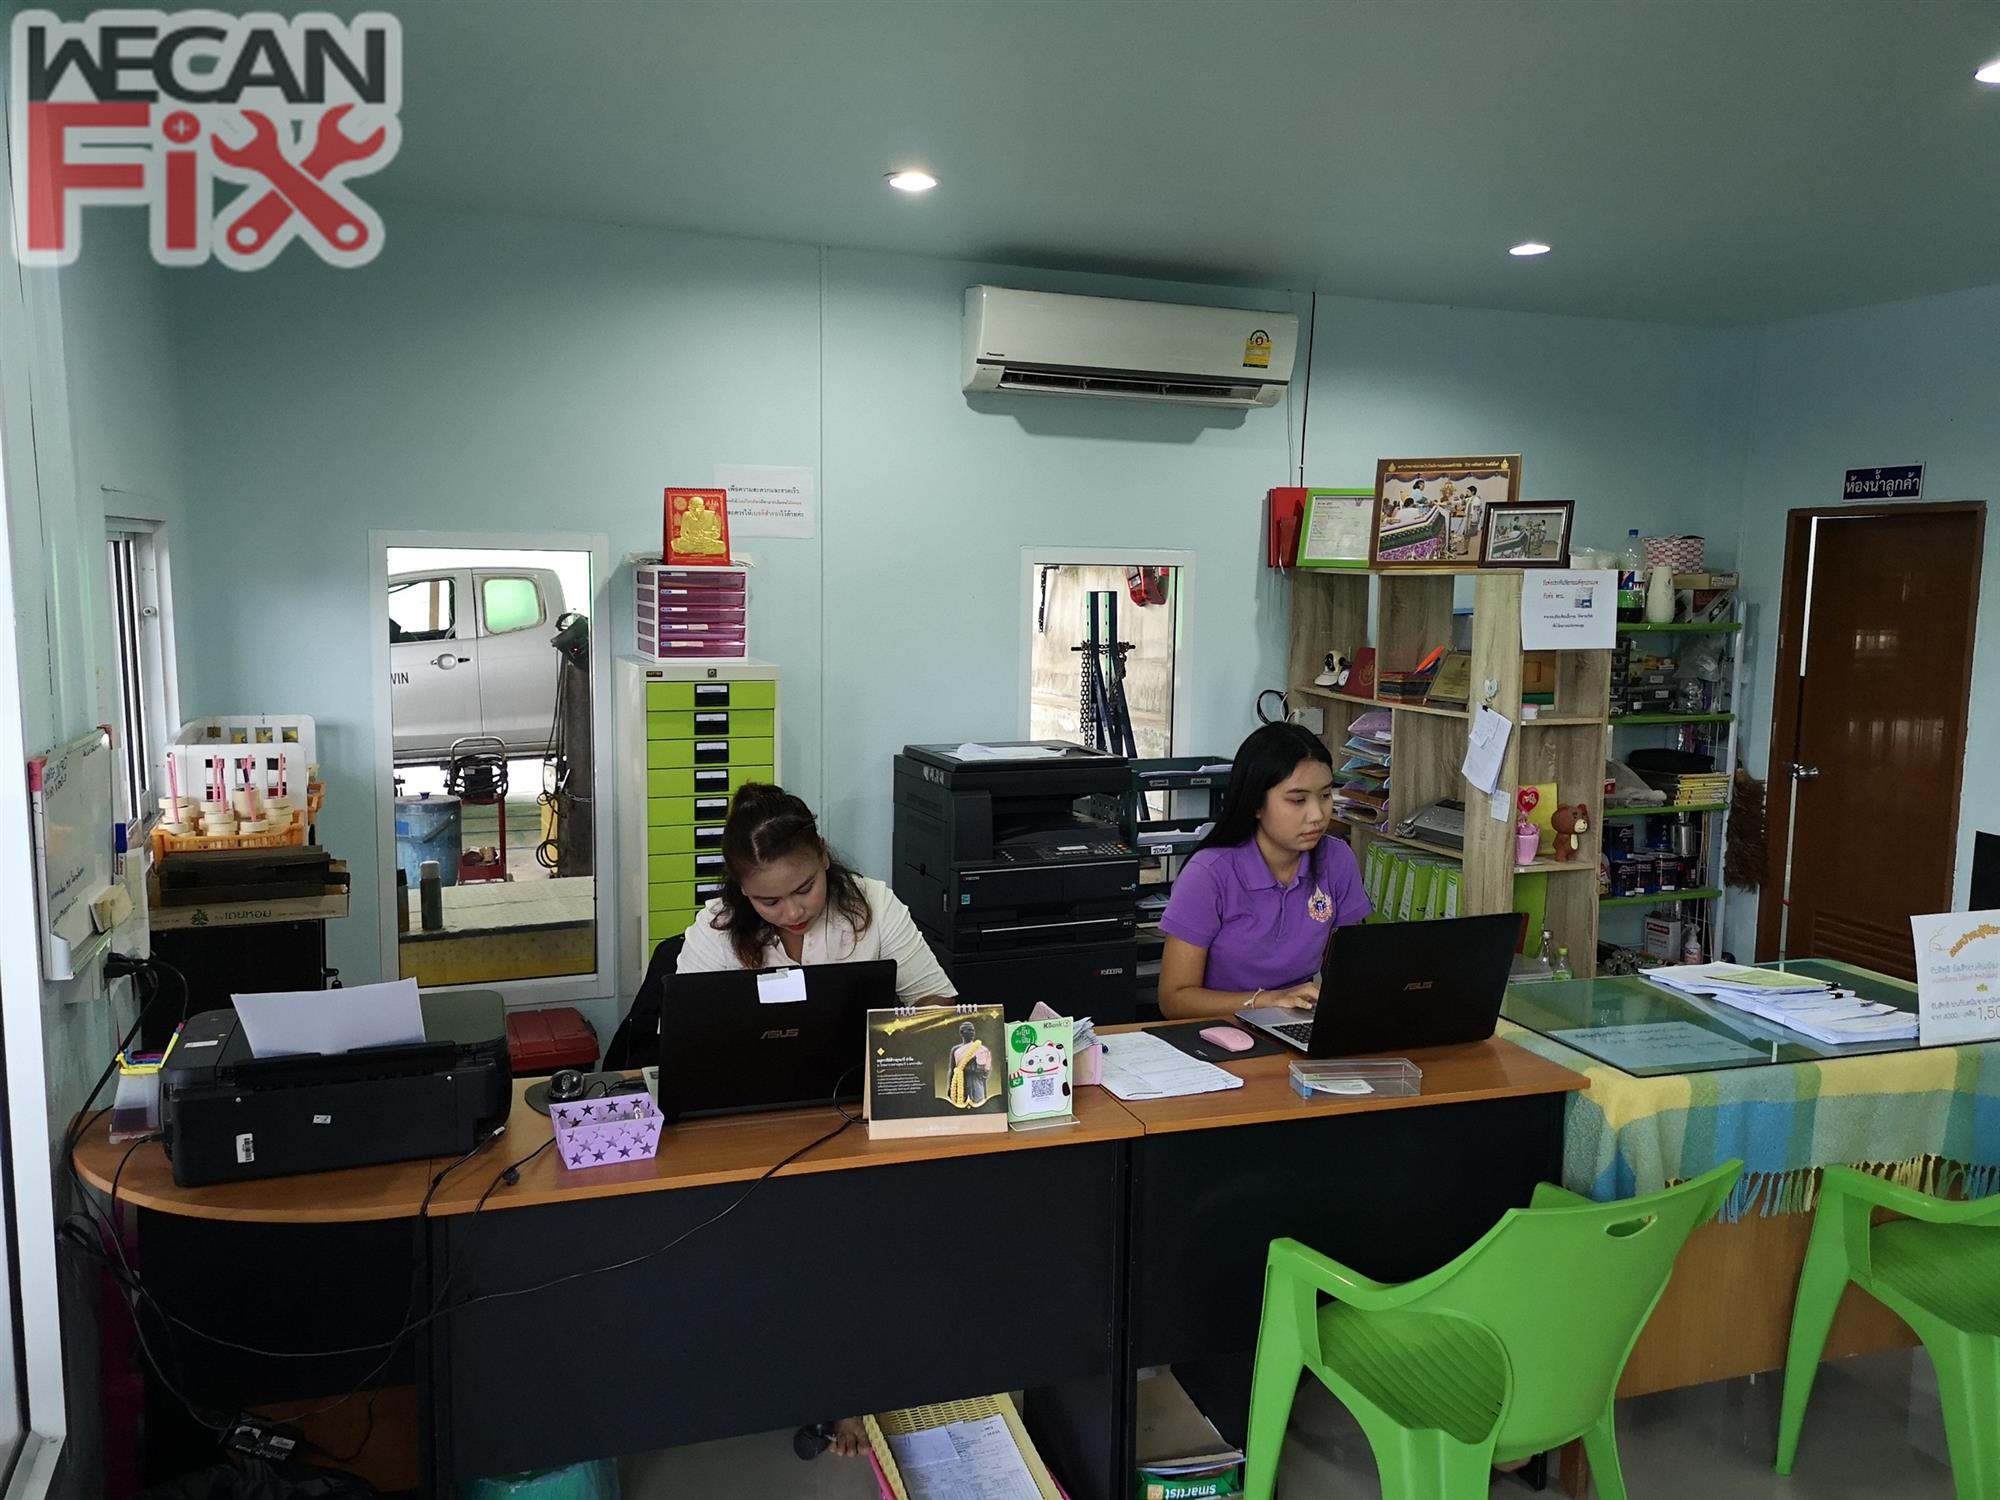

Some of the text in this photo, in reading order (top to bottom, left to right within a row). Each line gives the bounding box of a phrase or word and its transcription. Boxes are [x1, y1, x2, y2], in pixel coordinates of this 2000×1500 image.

[1845, 469, 1920, 497] ห้องน้ำลูกค้า
[1402, 981, 1433, 991] ASUS
[760, 1028, 800, 1040] ASUS
[1165, 1484, 1217, 1500] smartist
